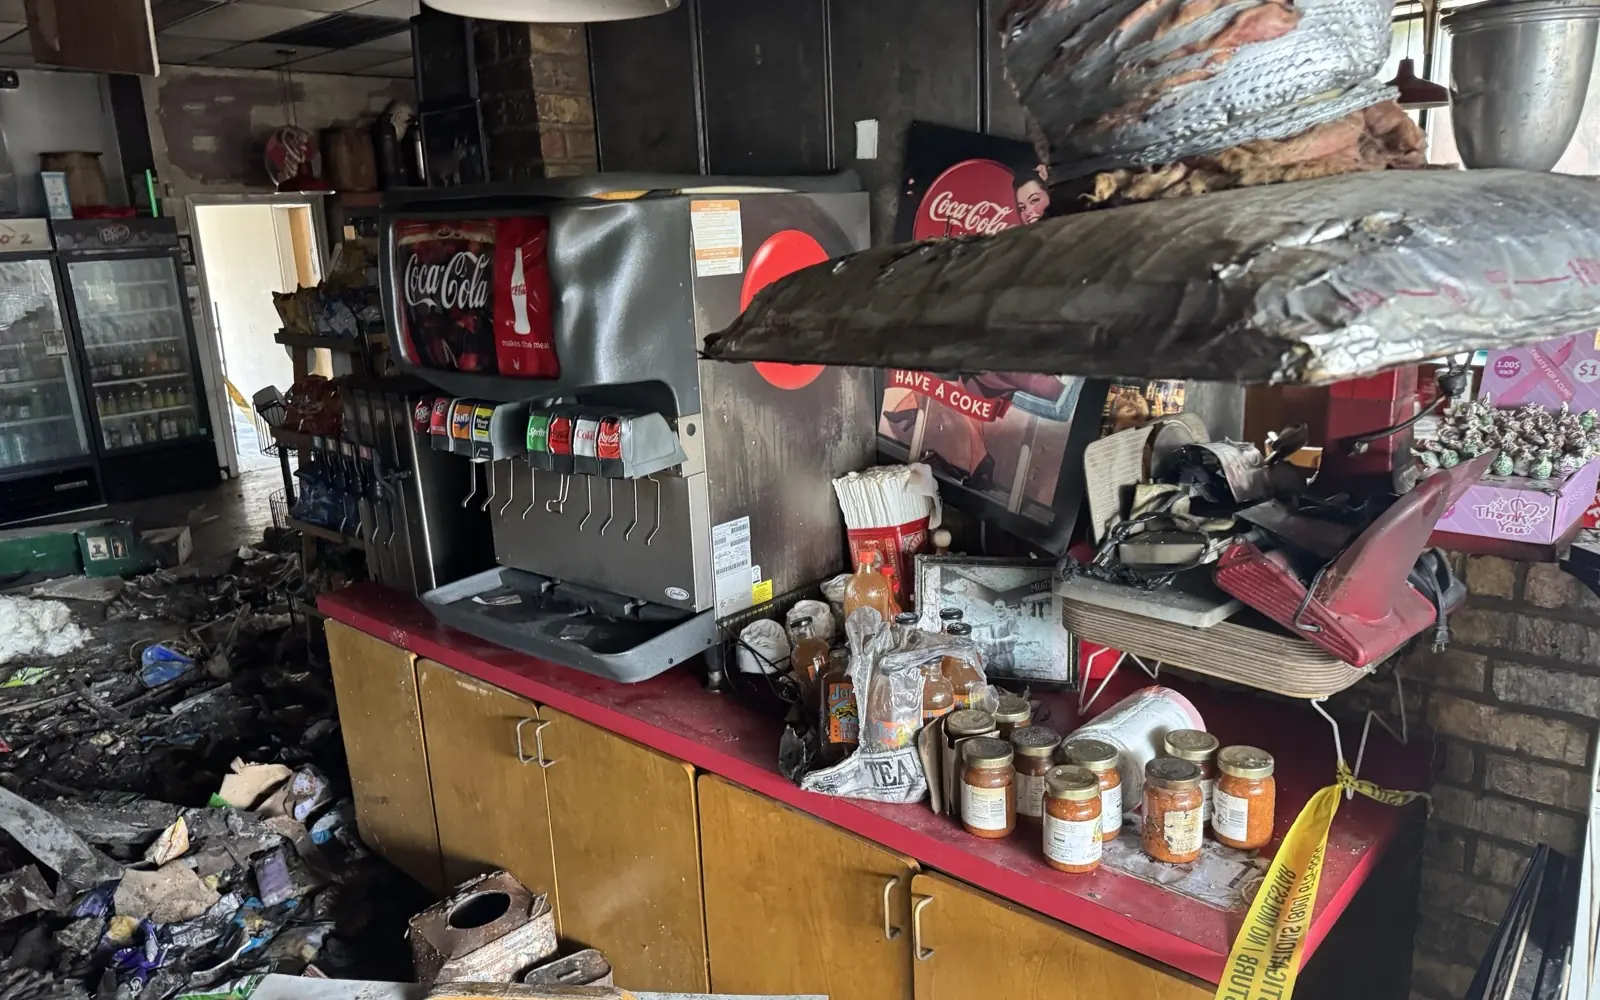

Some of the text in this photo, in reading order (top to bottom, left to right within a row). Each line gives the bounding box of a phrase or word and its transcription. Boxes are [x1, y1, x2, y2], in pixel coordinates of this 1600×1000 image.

[929, 191, 1014, 235] Coca-Cola
[404, 251, 490, 310] Coca-Cola
[1578, 362, 1598, 378] $1
[895, 370, 992, 418] HAVE A COKE
[1474, 505, 1527, 524] Thank
[1498, 520, 1525, 535] You
[864, 760, 915, 787] TEA
